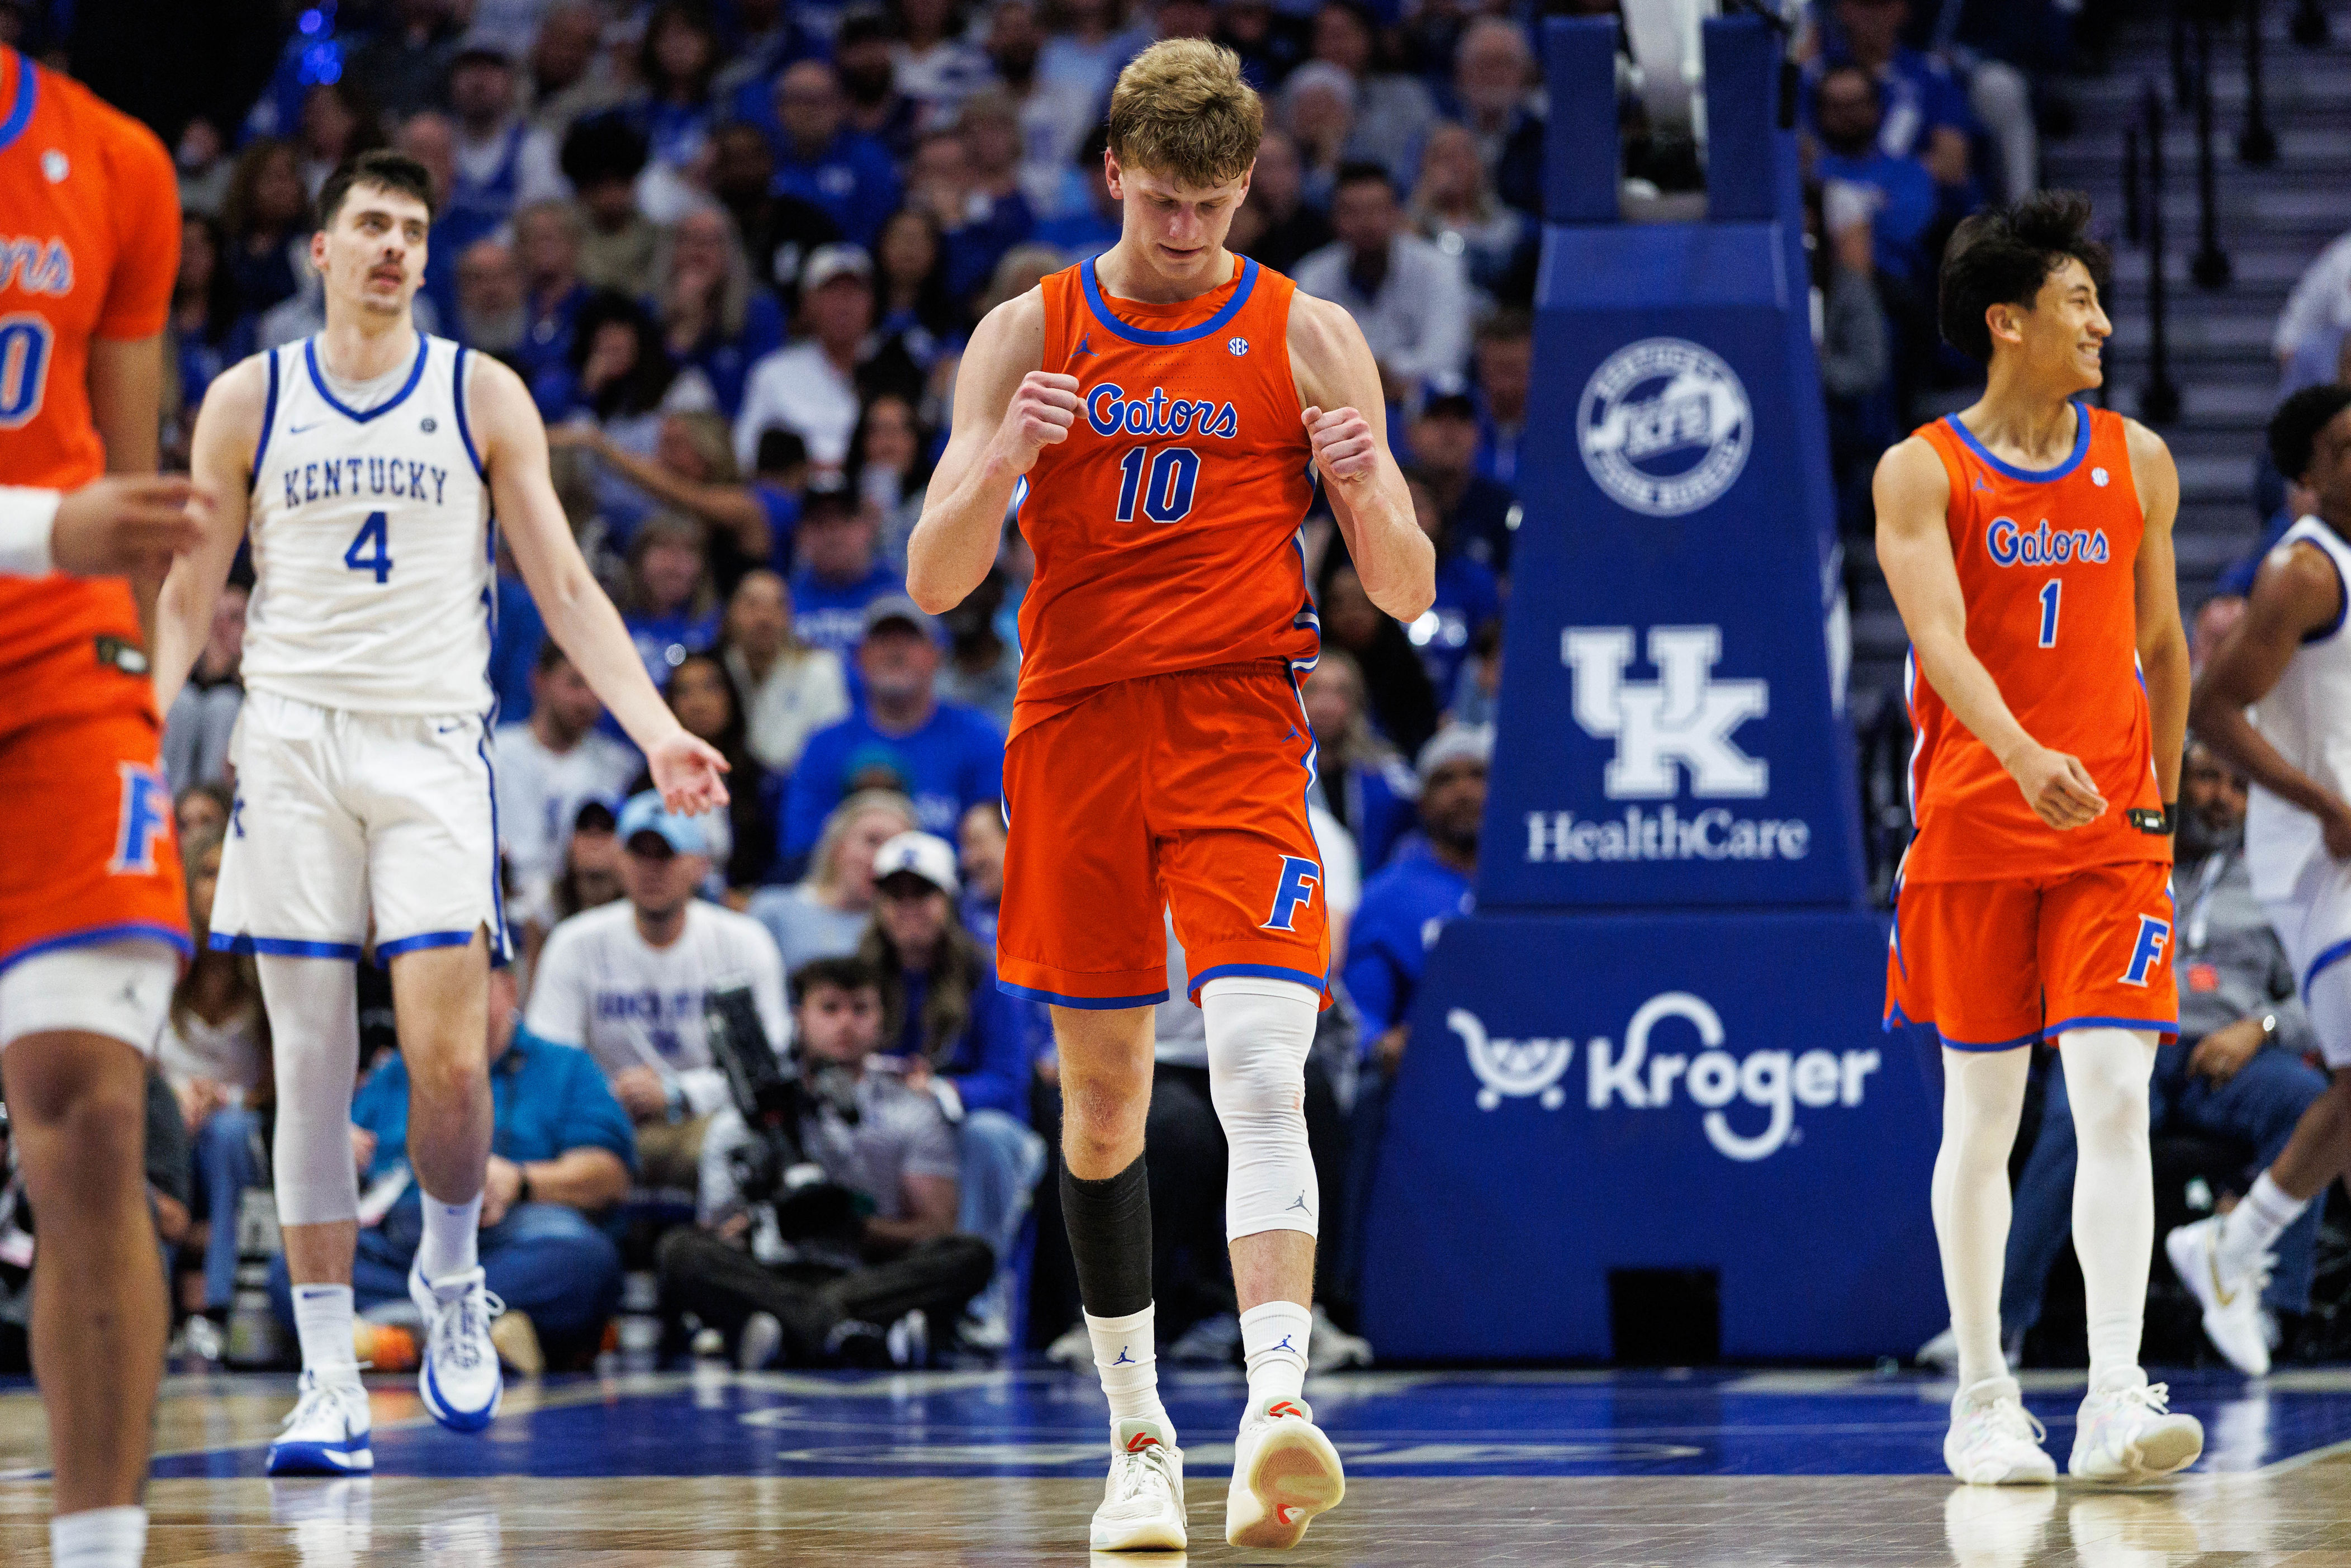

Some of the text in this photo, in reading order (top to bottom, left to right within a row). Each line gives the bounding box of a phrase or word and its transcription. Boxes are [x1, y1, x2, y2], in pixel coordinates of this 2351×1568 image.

[1229, 337, 1248, 356] SEC
[1087, 382, 1238, 438] Gators
[284, 457, 448, 509] KENTUCKY
[1116, 447, 1201, 523] 10
[344, 511, 393, 584] 4
[1986, 515, 2110, 567] Gators
[2038, 578, 2063, 648] 1
[1562, 626, 1768, 798] UK
[108, 760, 171, 876] F
[1526, 806, 1810, 861] HealthCare
[1259, 855, 1320, 932] F
[2118, 912, 2171, 988] F
[1586, 991, 1881, 1162] Kroger
